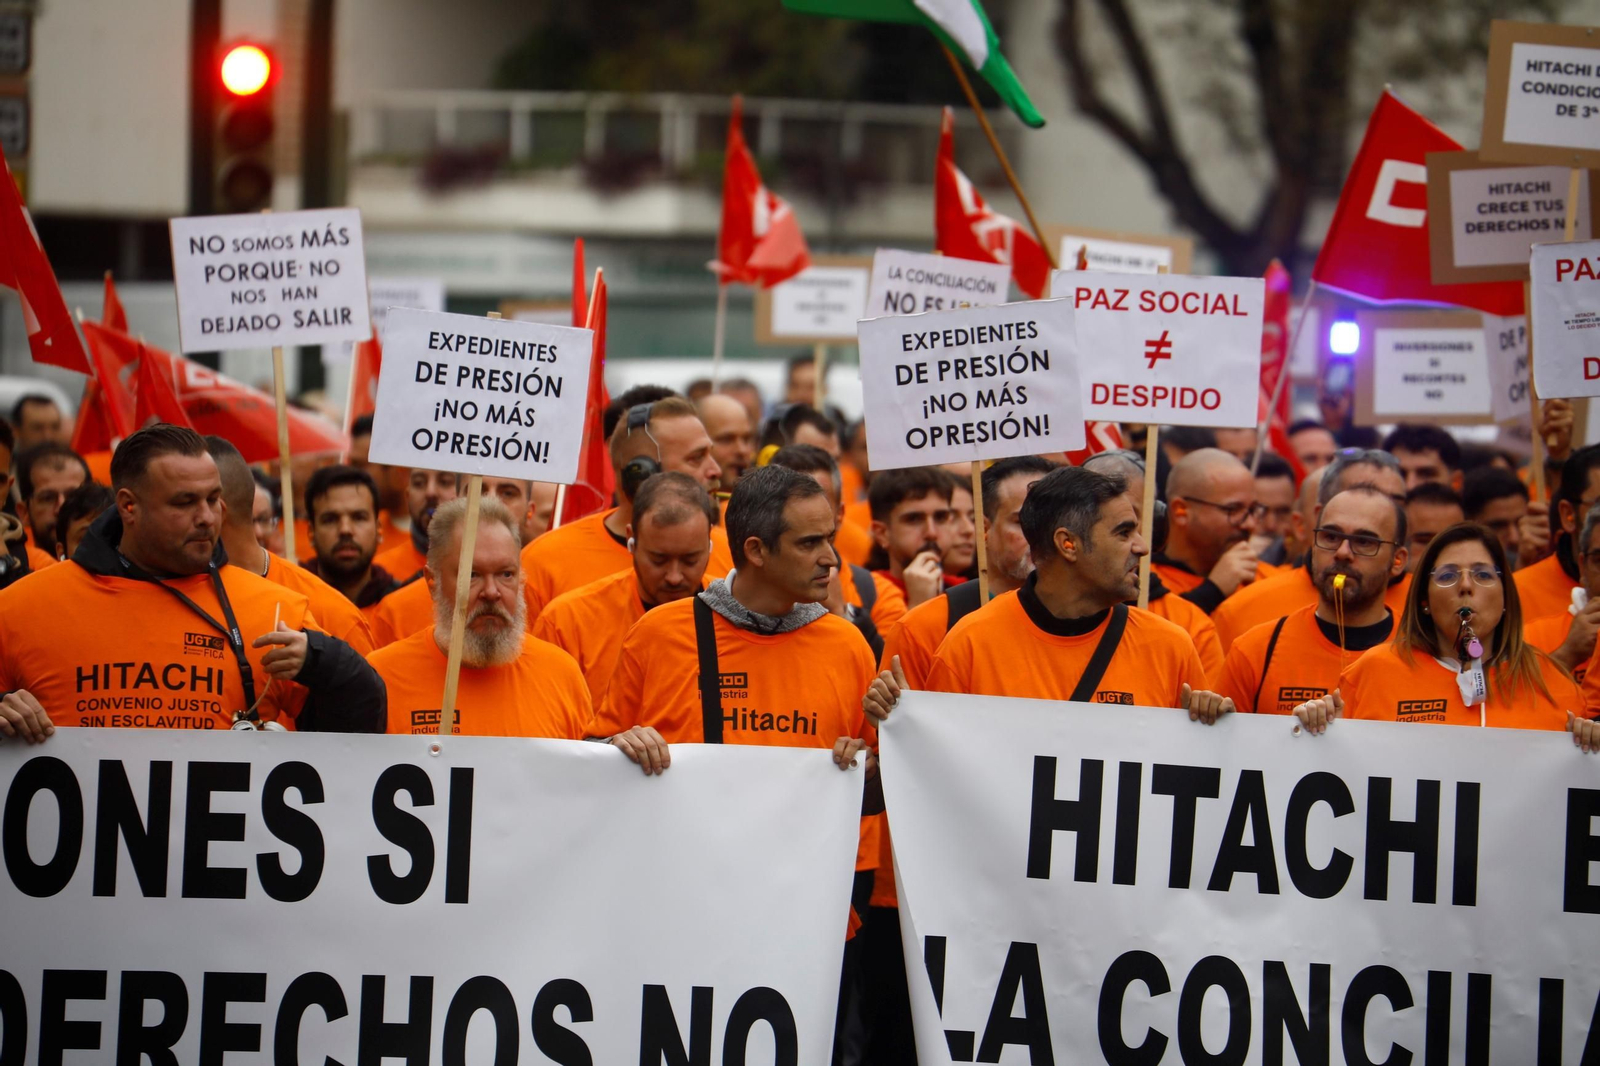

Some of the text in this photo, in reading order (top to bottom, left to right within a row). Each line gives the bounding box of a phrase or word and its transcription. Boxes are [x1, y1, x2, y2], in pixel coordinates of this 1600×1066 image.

[1526, 60, 1591, 77] HITACHI
[1521, 80, 1600, 99] CONDICIO
[1556, 103, 1577, 117] DE
[1488, 182, 1551, 195] HITACHI
[1477, 199, 1563, 215] CRECE TUS
[189, 222, 350, 255] NO SOMOS MÁS
[1465, 219, 1550, 234] DERECHOS
[204, 259, 340, 283] PORQUE NO
[888, 266, 997, 294] LA CONCILIACIÓN
[231, 286, 318, 305] NOS HAN
[884, 290, 916, 314] NO
[1075, 287, 1248, 316] PAZ SOCIAL
[201, 313, 281, 334] DEJADO
[293, 307, 353, 329] SALIR
[428, 331, 557, 363] EXPEDIENTES
[902, 321, 1038, 351] EXPEDIENTES
[415, 361, 563, 398] DE PRESIÓN
[895, 346, 1050, 386] DE PRESIÓN
[923, 381, 1028, 419] ¡NO MÁS
[1091, 383, 1221, 410] DESPIDO
[434, 399, 536, 427] ¡NO MÁS
[906, 411, 1050, 449] OPRESIÓN!
[411, 428, 550, 464] OPRESIÓN!
[185, 634, 212, 647] UGT
[203, 648, 225, 660] FICA
[76, 662, 224, 696] HITACHI
[76, 697, 222, 714] CONVENIO JUSTO
[1097, 692, 1123, 703] UGT
[79, 715, 215, 730] SIN ESCLAVITUD
[721, 708, 817, 736] Hitachi
[1395, 713, 1446, 722] industria
[3, 756, 475, 905] ONES SI
[1026, 755, 1481, 907] HITACHI
[640, 984, 799, 1066] NO
